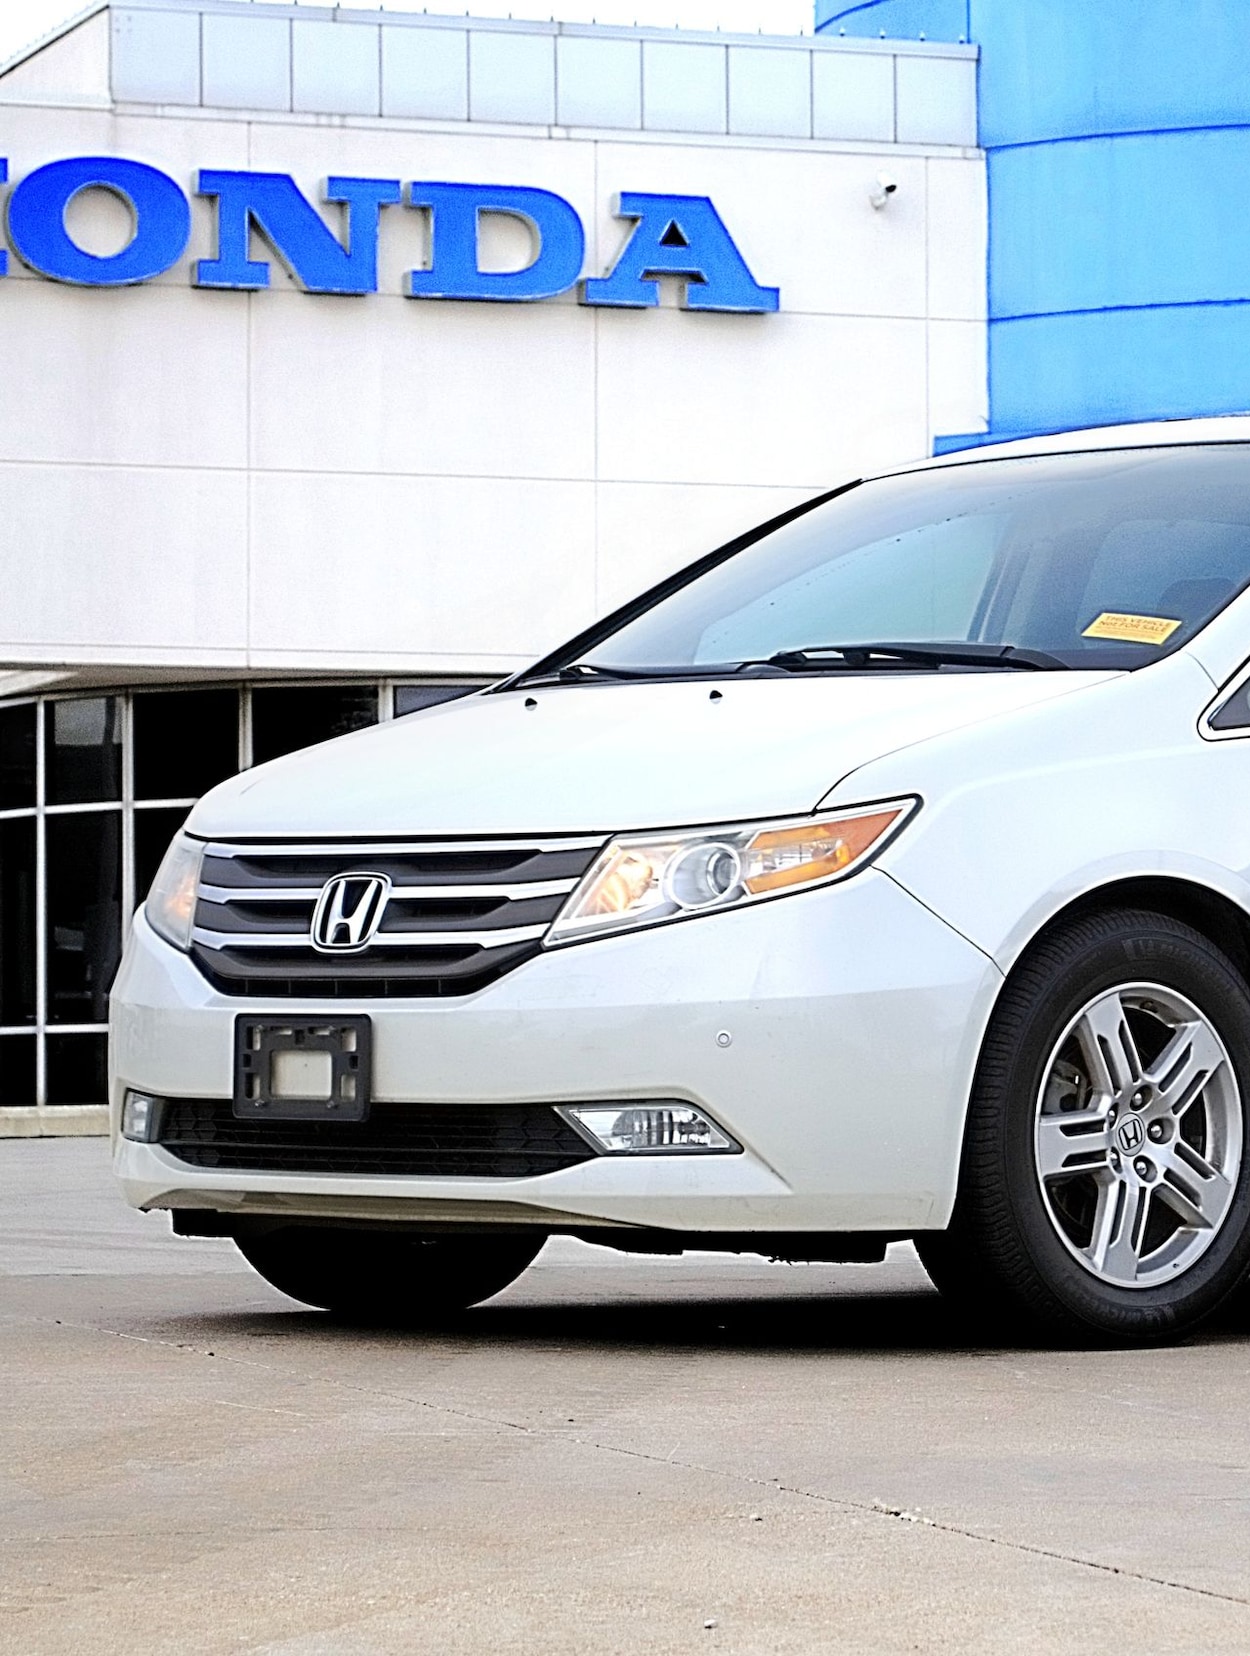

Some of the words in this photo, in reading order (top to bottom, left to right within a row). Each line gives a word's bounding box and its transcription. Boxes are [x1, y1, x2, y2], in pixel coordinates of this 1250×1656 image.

[0, 156, 780, 314] ONDA
[1131, 617, 1172, 628] VEHICLE
[1142, 624, 1168, 632] SALE
